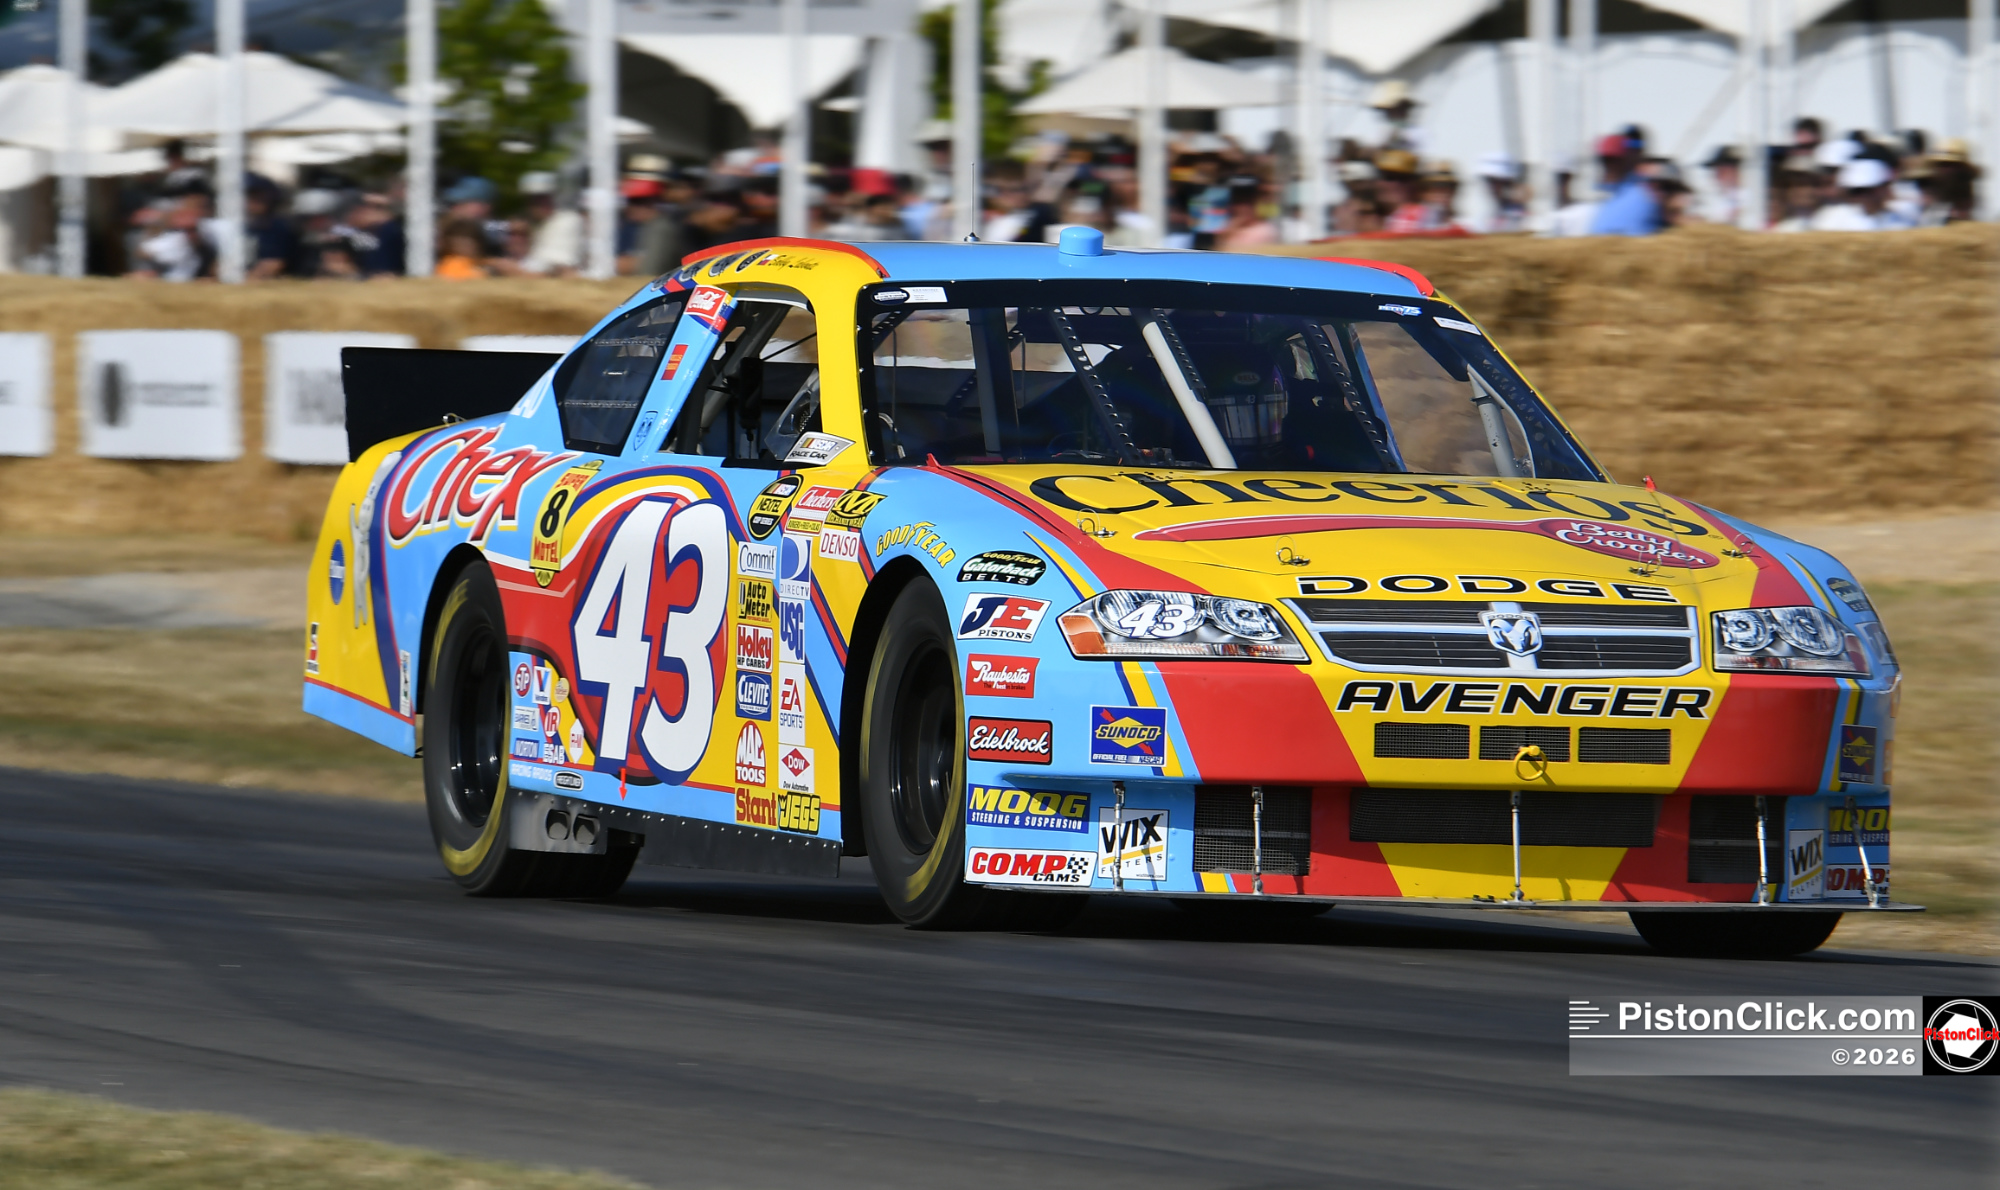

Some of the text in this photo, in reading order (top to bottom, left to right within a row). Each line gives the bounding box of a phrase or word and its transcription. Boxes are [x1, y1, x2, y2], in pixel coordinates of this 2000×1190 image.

[384, 423, 584, 549] Chex
[798, 489, 837, 510] Checkers
[540, 489, 568, 539] 8
[1029, 472, 1709, 537] Cheerios
[820, 532, 858, 558] DENSO
[875, 521, 957, 569] GOODYEAR
[1555, 529, 1707, 566] Crocker
[1570, 522, 1673, 550] Betty
[739, 544, 776, 573] Commit
[962, 559, 1039, 579] Gatorback
[982, 552, 1042, 565] GOODYEAR
[747, 581, 767, 600] Auto
[780, 583, 810, 597] DIRECTV
[962, 573, 1029, 585] BELTS
[1297, 574, 1680, 604] DODGE
[745, 599, 771, 618] Meter
[960, 597, 1043, 636] JE
[1118, 602, 1197, 638] 43
[573, 499, 729, 773] 43
[780, 601, 804, 661] USG
[978, 629, 1033, 641] PISTONS
[737, 625, 772, 669] Holley
[737, 656, 765, 669] HP CARBS
[970, 660, 1031, 689] Raybestos
[515, 666, 530, 692] STP
[738, 674, 769, 706] CLEVITE
[780, 678, 802, 713] EA
[1335, 680, 1715, 720] AVENGER
[779, 712, 803, 729] SPORTS
[1097, 725, 1160, 740] SUNOCO
[543, 743, 565, 765] ESAB
[969, 725, 1050, 755] Edelbrock
[736, 765, 766, 784] TOOLS
[736, 787, 777, 827] Stant
[779, 795, 820, 834] JEGS
[969, 787, 1088, 818] MOOG
[971, 811, 1082, 830] STEERING & SUSPENSION
[971, 851, 1068, 876] COMP
[1790, 833, 1823, 876] WIX
[1032, 872, 1081, 883] CAMS
